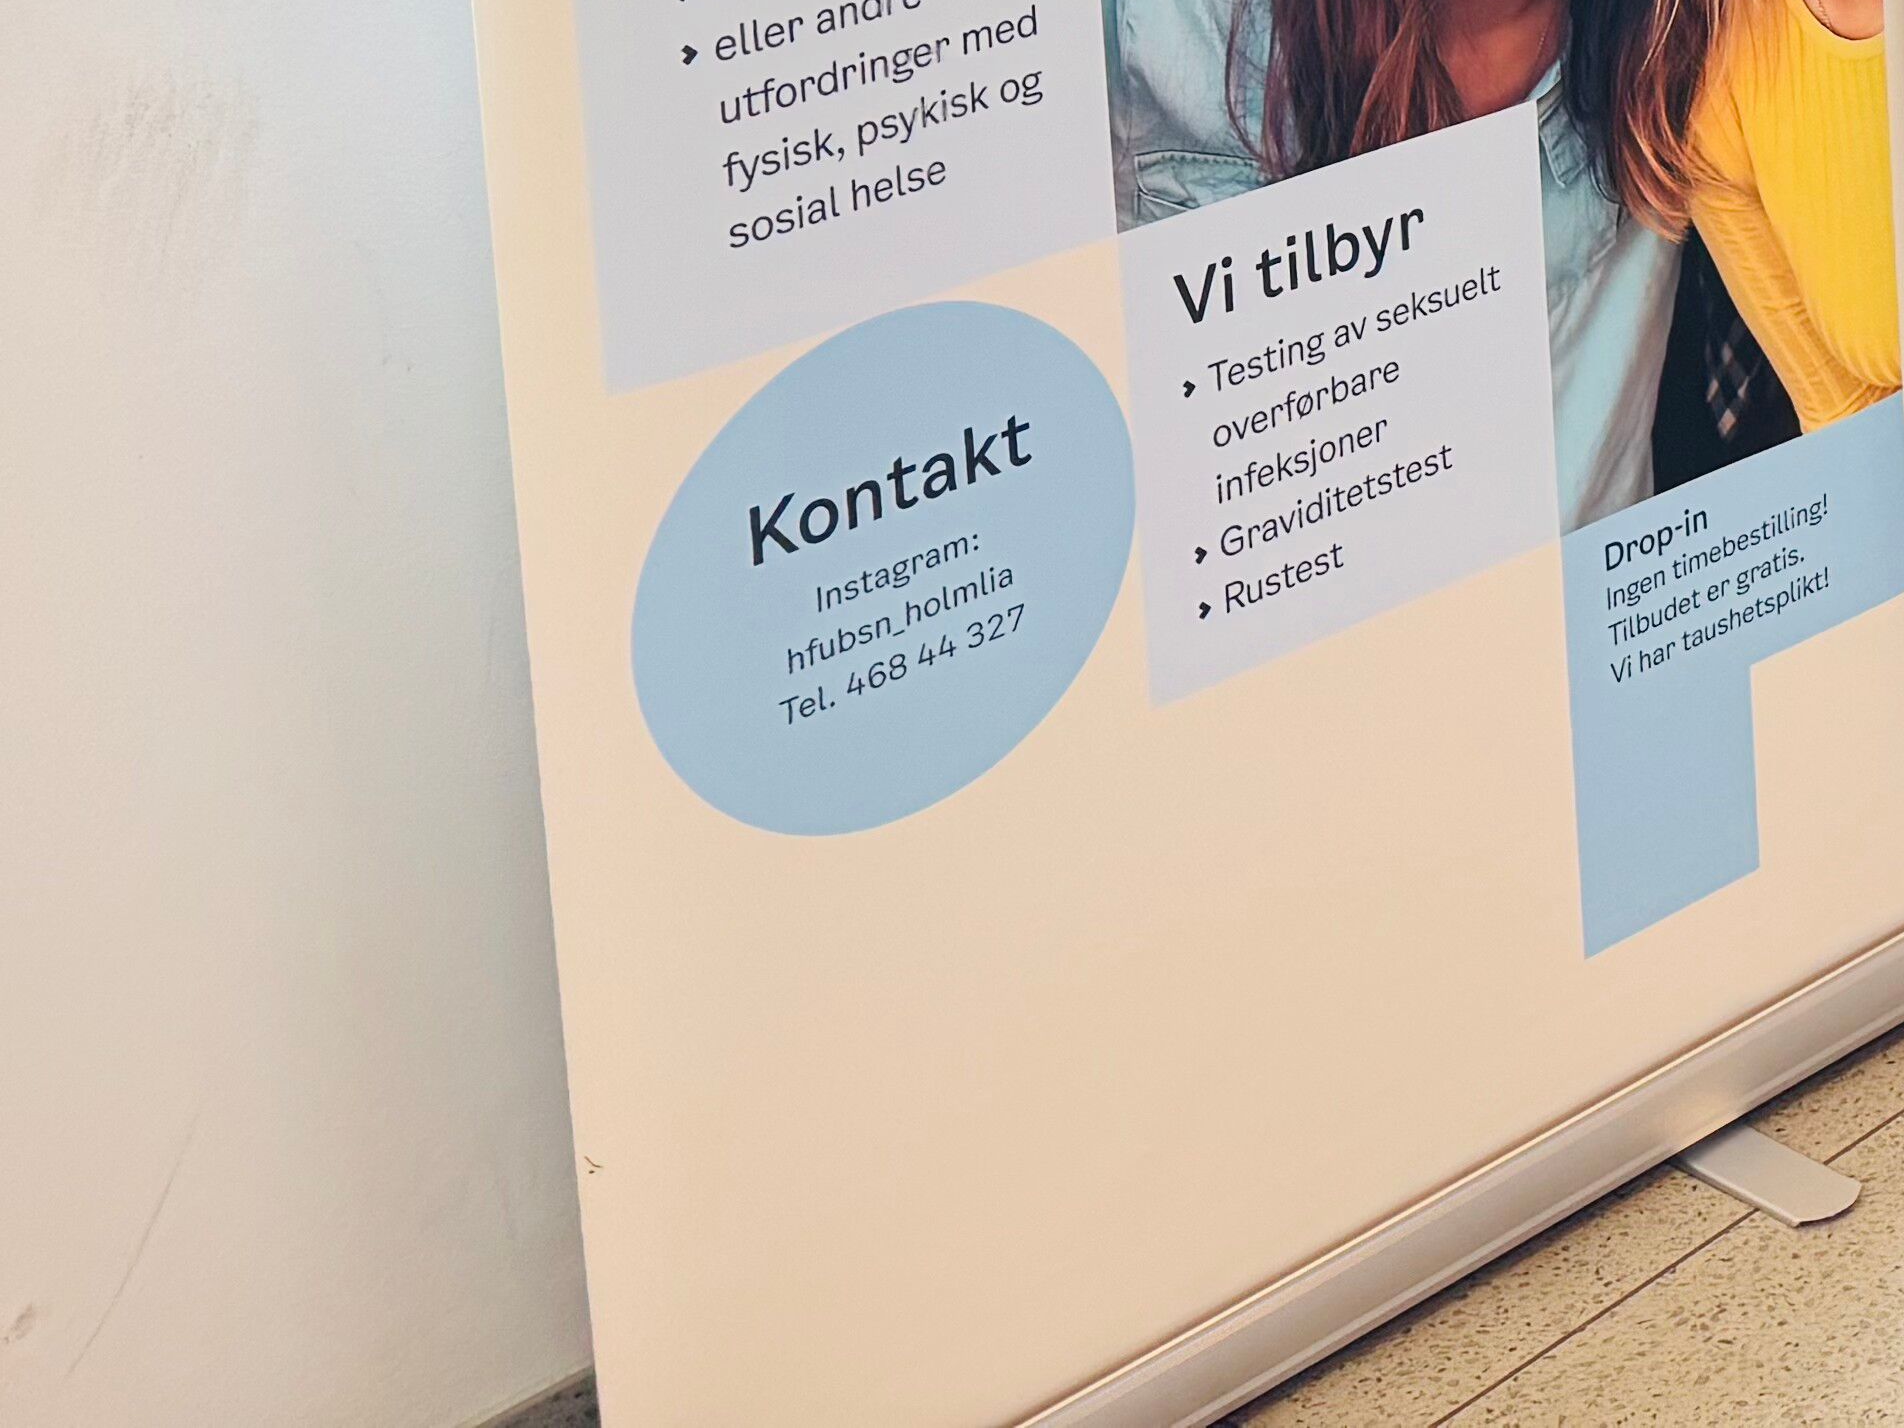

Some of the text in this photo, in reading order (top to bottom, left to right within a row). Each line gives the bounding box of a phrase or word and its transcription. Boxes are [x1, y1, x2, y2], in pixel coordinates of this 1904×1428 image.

[715, 16, 804, 61] eller
[720, 4, 1038, 125] utfordringer med
[722, 70, 1044, 193] fysisk, psykisk og
[729, 157, 946, 249] sosial helse
[1172, 208, 1424, 324] Vi tilbyr
[1207, 266, 1501, 392] Testing av seksuelt
[1213, 360, 1400, 449] overførbare
[749, 414, 1033, 566] Kontakt
[1213, 418, 1387, 504] infeksjoner
[1220, 443, 1453, 557] Graviditetstest
[816, 533, 979, 612] Instagram:
[1225, 543, 1345, 614] Rustest
[1604, 508, 1709, 571] Drop-in
[1606, 493, 1829, 611] Ingen timebestilling!
[787, 566, 1014, 674] hfubsn_holmlia
[1607, 547, 1805, 646] Tilbudet er gratis.
[1610, 567, 1829, 683] Vi har taushetsplikt!
[778, 603, 1025, 725] Tel. 468 44 327
